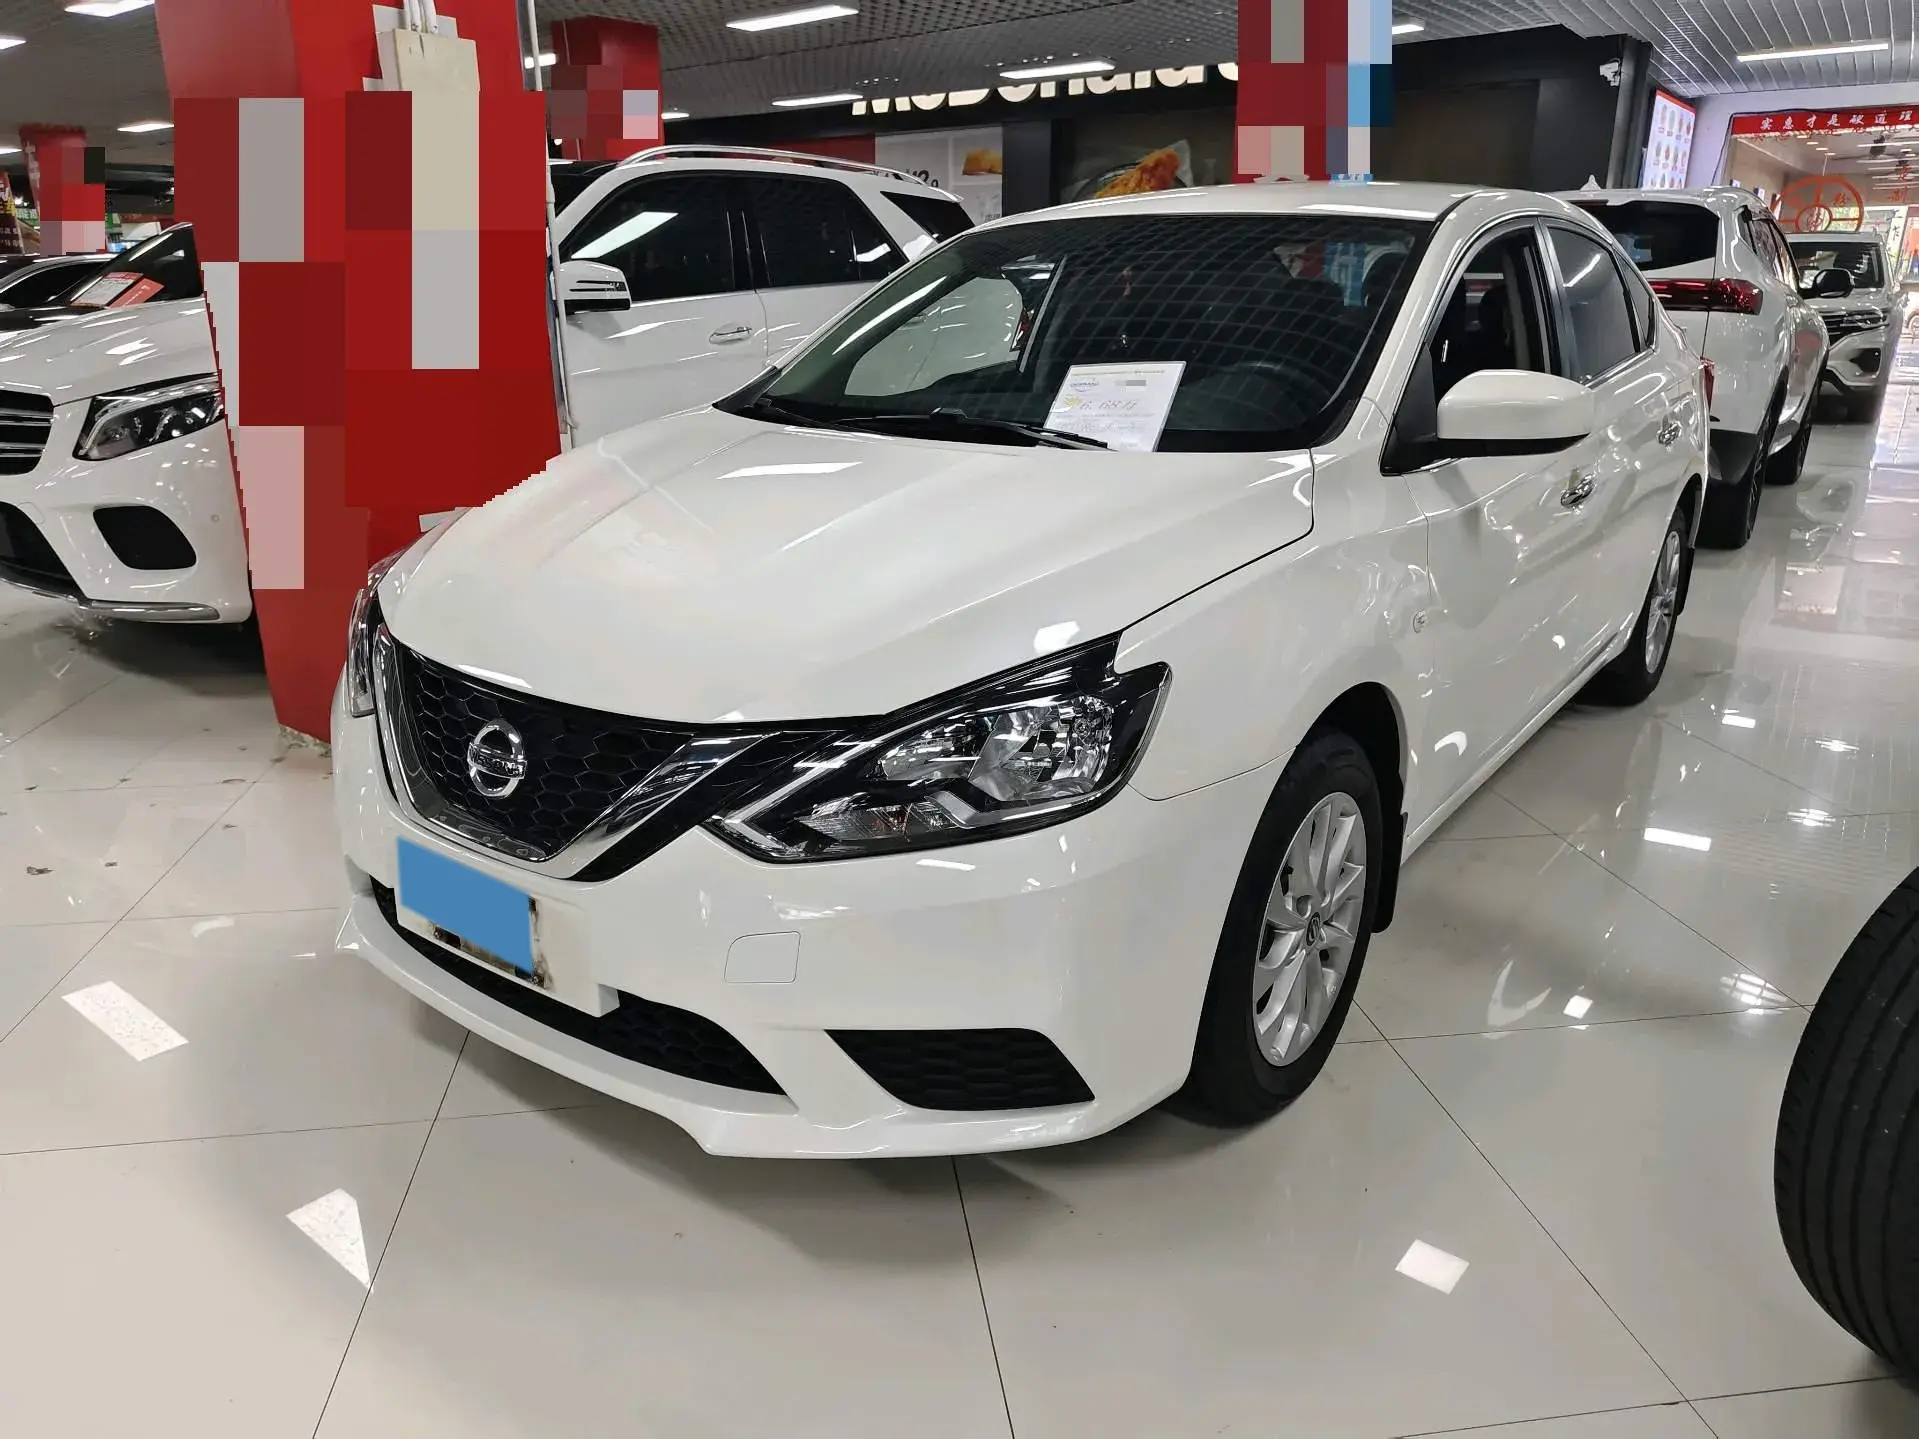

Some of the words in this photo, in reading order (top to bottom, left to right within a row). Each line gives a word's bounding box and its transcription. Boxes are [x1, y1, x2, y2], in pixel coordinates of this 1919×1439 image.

[1760, 110, 1914, 130] 实惠才是硬道理
